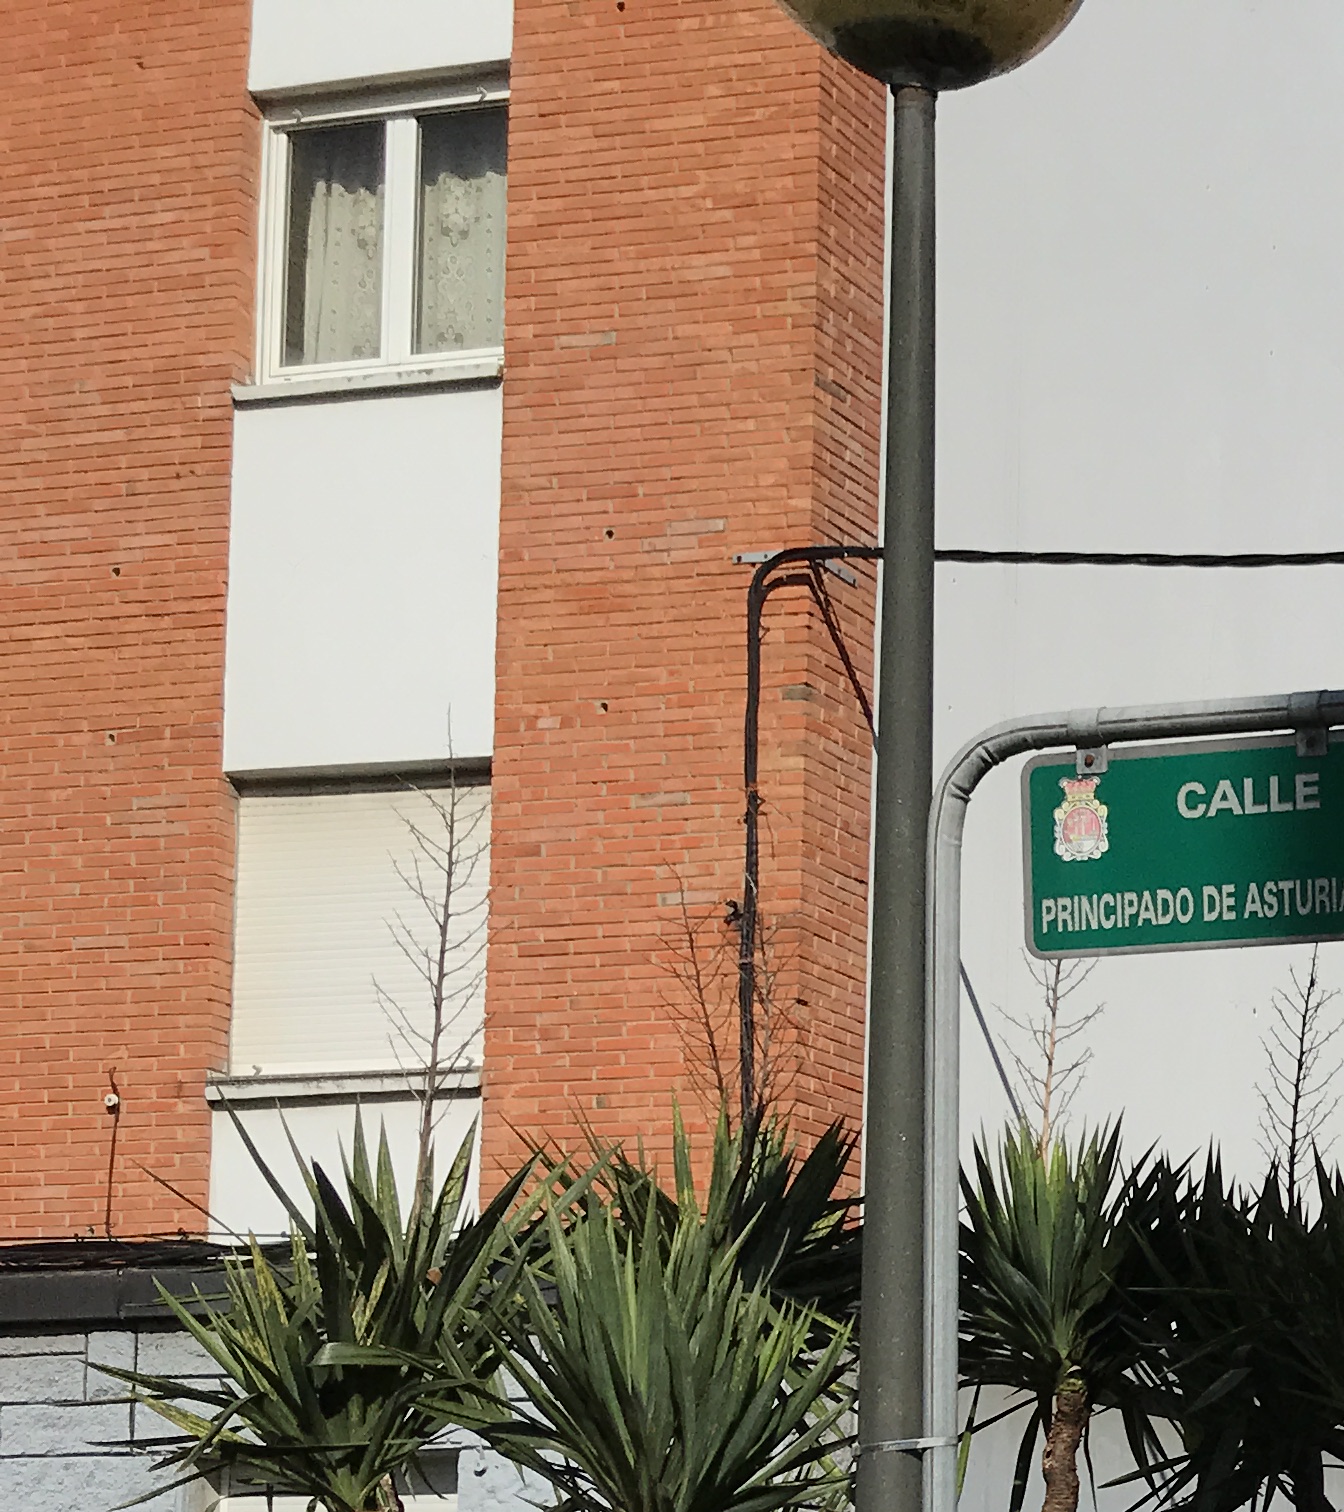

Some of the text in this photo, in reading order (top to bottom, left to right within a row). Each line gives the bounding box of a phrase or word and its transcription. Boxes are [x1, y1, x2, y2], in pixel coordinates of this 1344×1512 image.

[1178, 774, 1321, 819] CALLE
[1042, 887, 1194, 933] PRINCIPADO
[1203, 884, 1236, 922] DE
